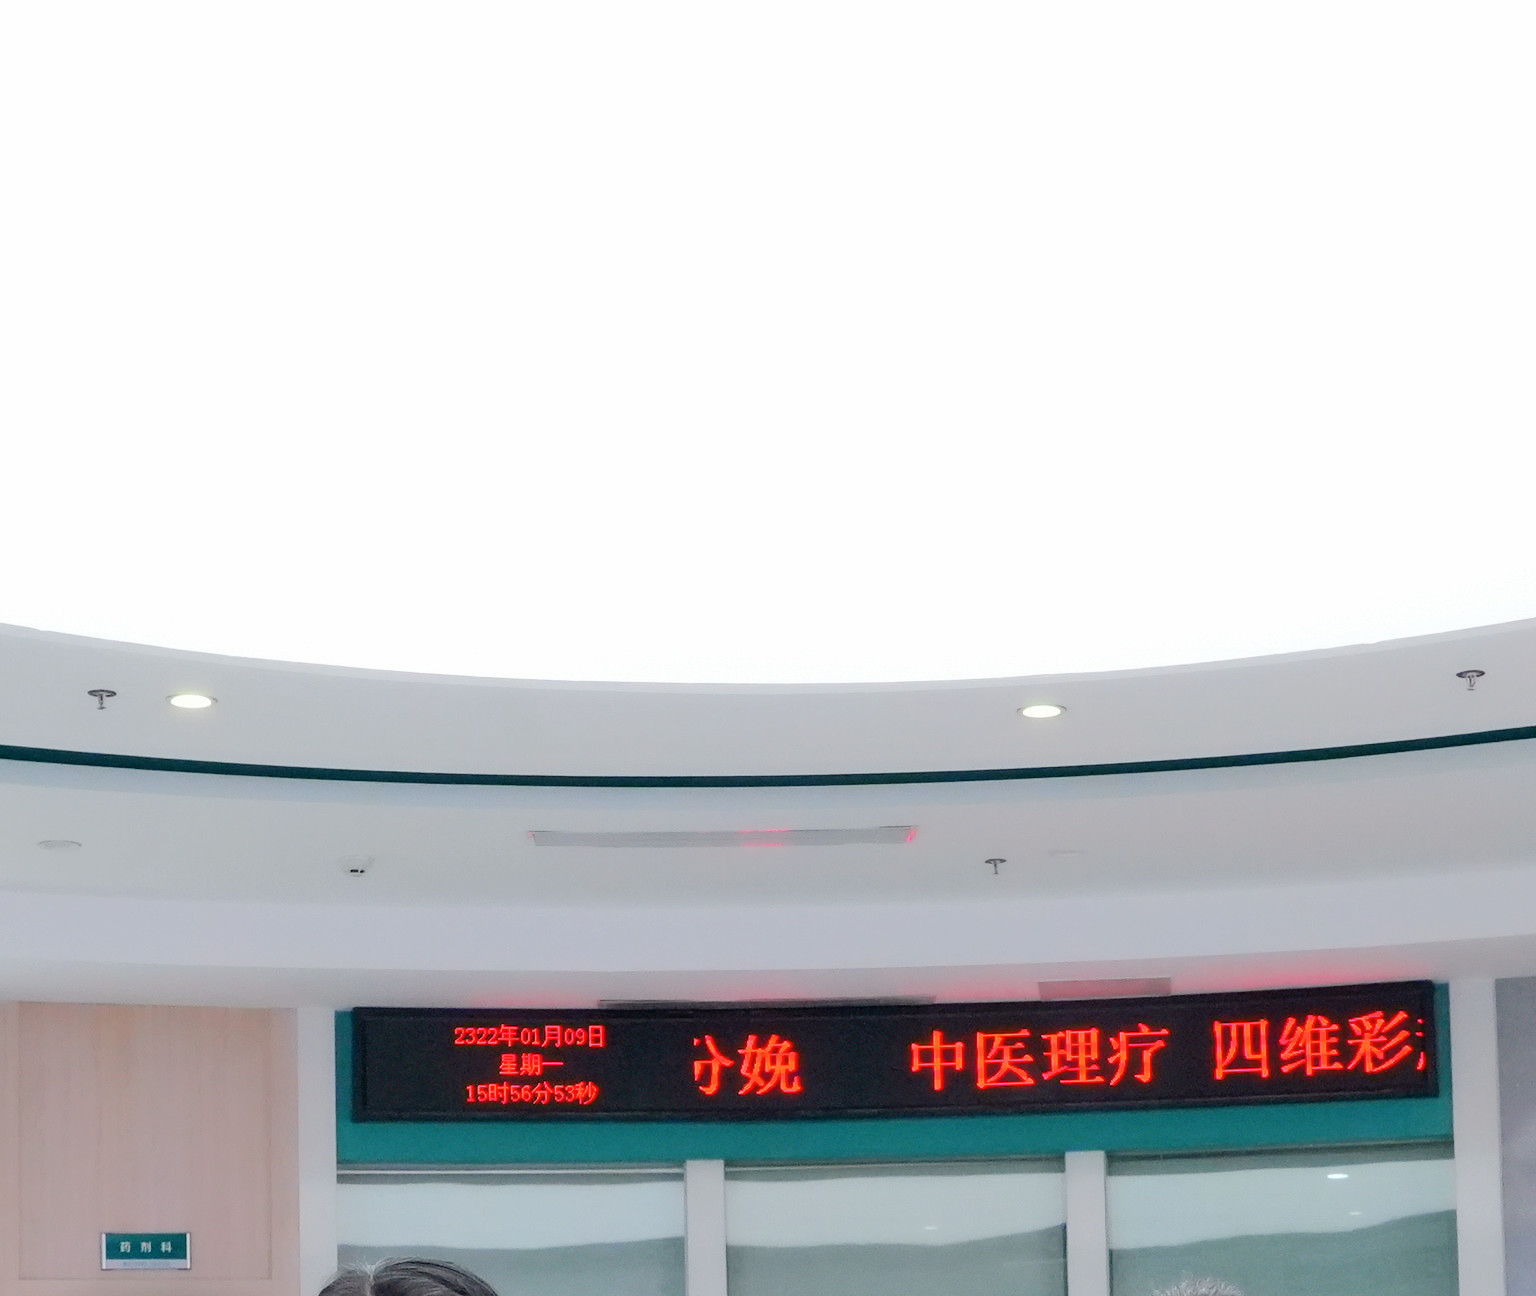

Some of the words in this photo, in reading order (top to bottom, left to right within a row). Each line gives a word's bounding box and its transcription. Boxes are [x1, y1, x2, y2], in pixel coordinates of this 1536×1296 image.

[910, 1023, 1169, 1091] 中医理疗
[1212, 1010, 1427, 1081] 四维彩
[498, 1052, 565, 1077] 星期一
[465, 1080, 601, 1106] 15时56分53秒
[119, 1240, 173, 1254] 药剂科
